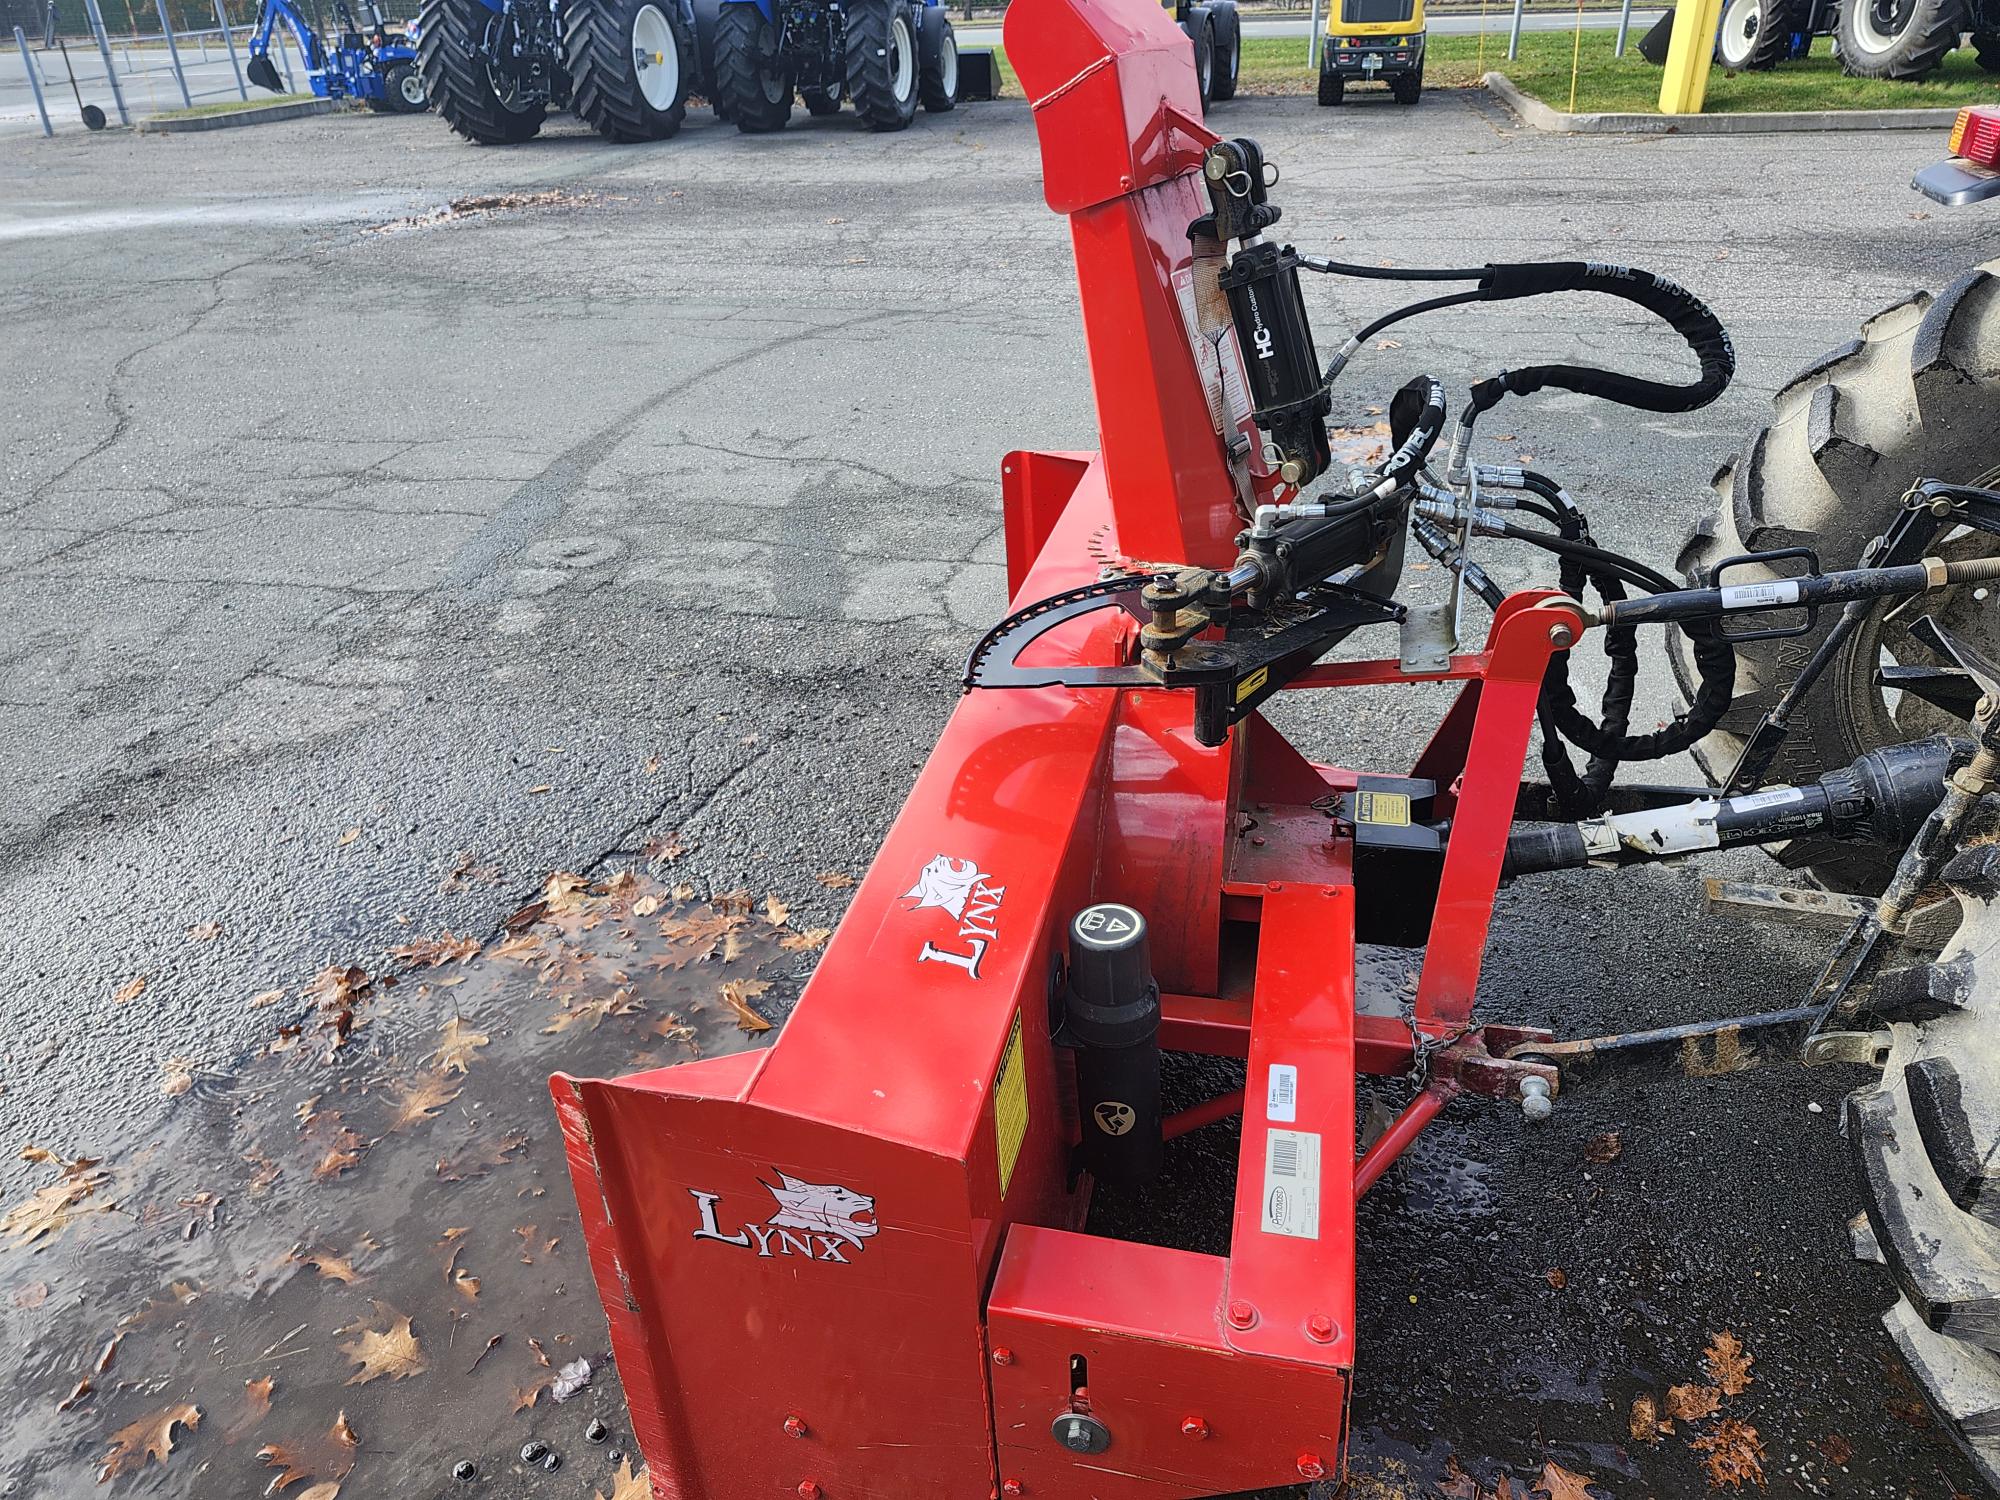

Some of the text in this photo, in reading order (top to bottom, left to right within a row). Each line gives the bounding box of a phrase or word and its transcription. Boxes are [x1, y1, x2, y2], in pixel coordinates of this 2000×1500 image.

[1253, 327, 1275, 361] HC
[917, 881, 1008, 980] LYNX
[687, 1187, 852, 1265] LYNX
